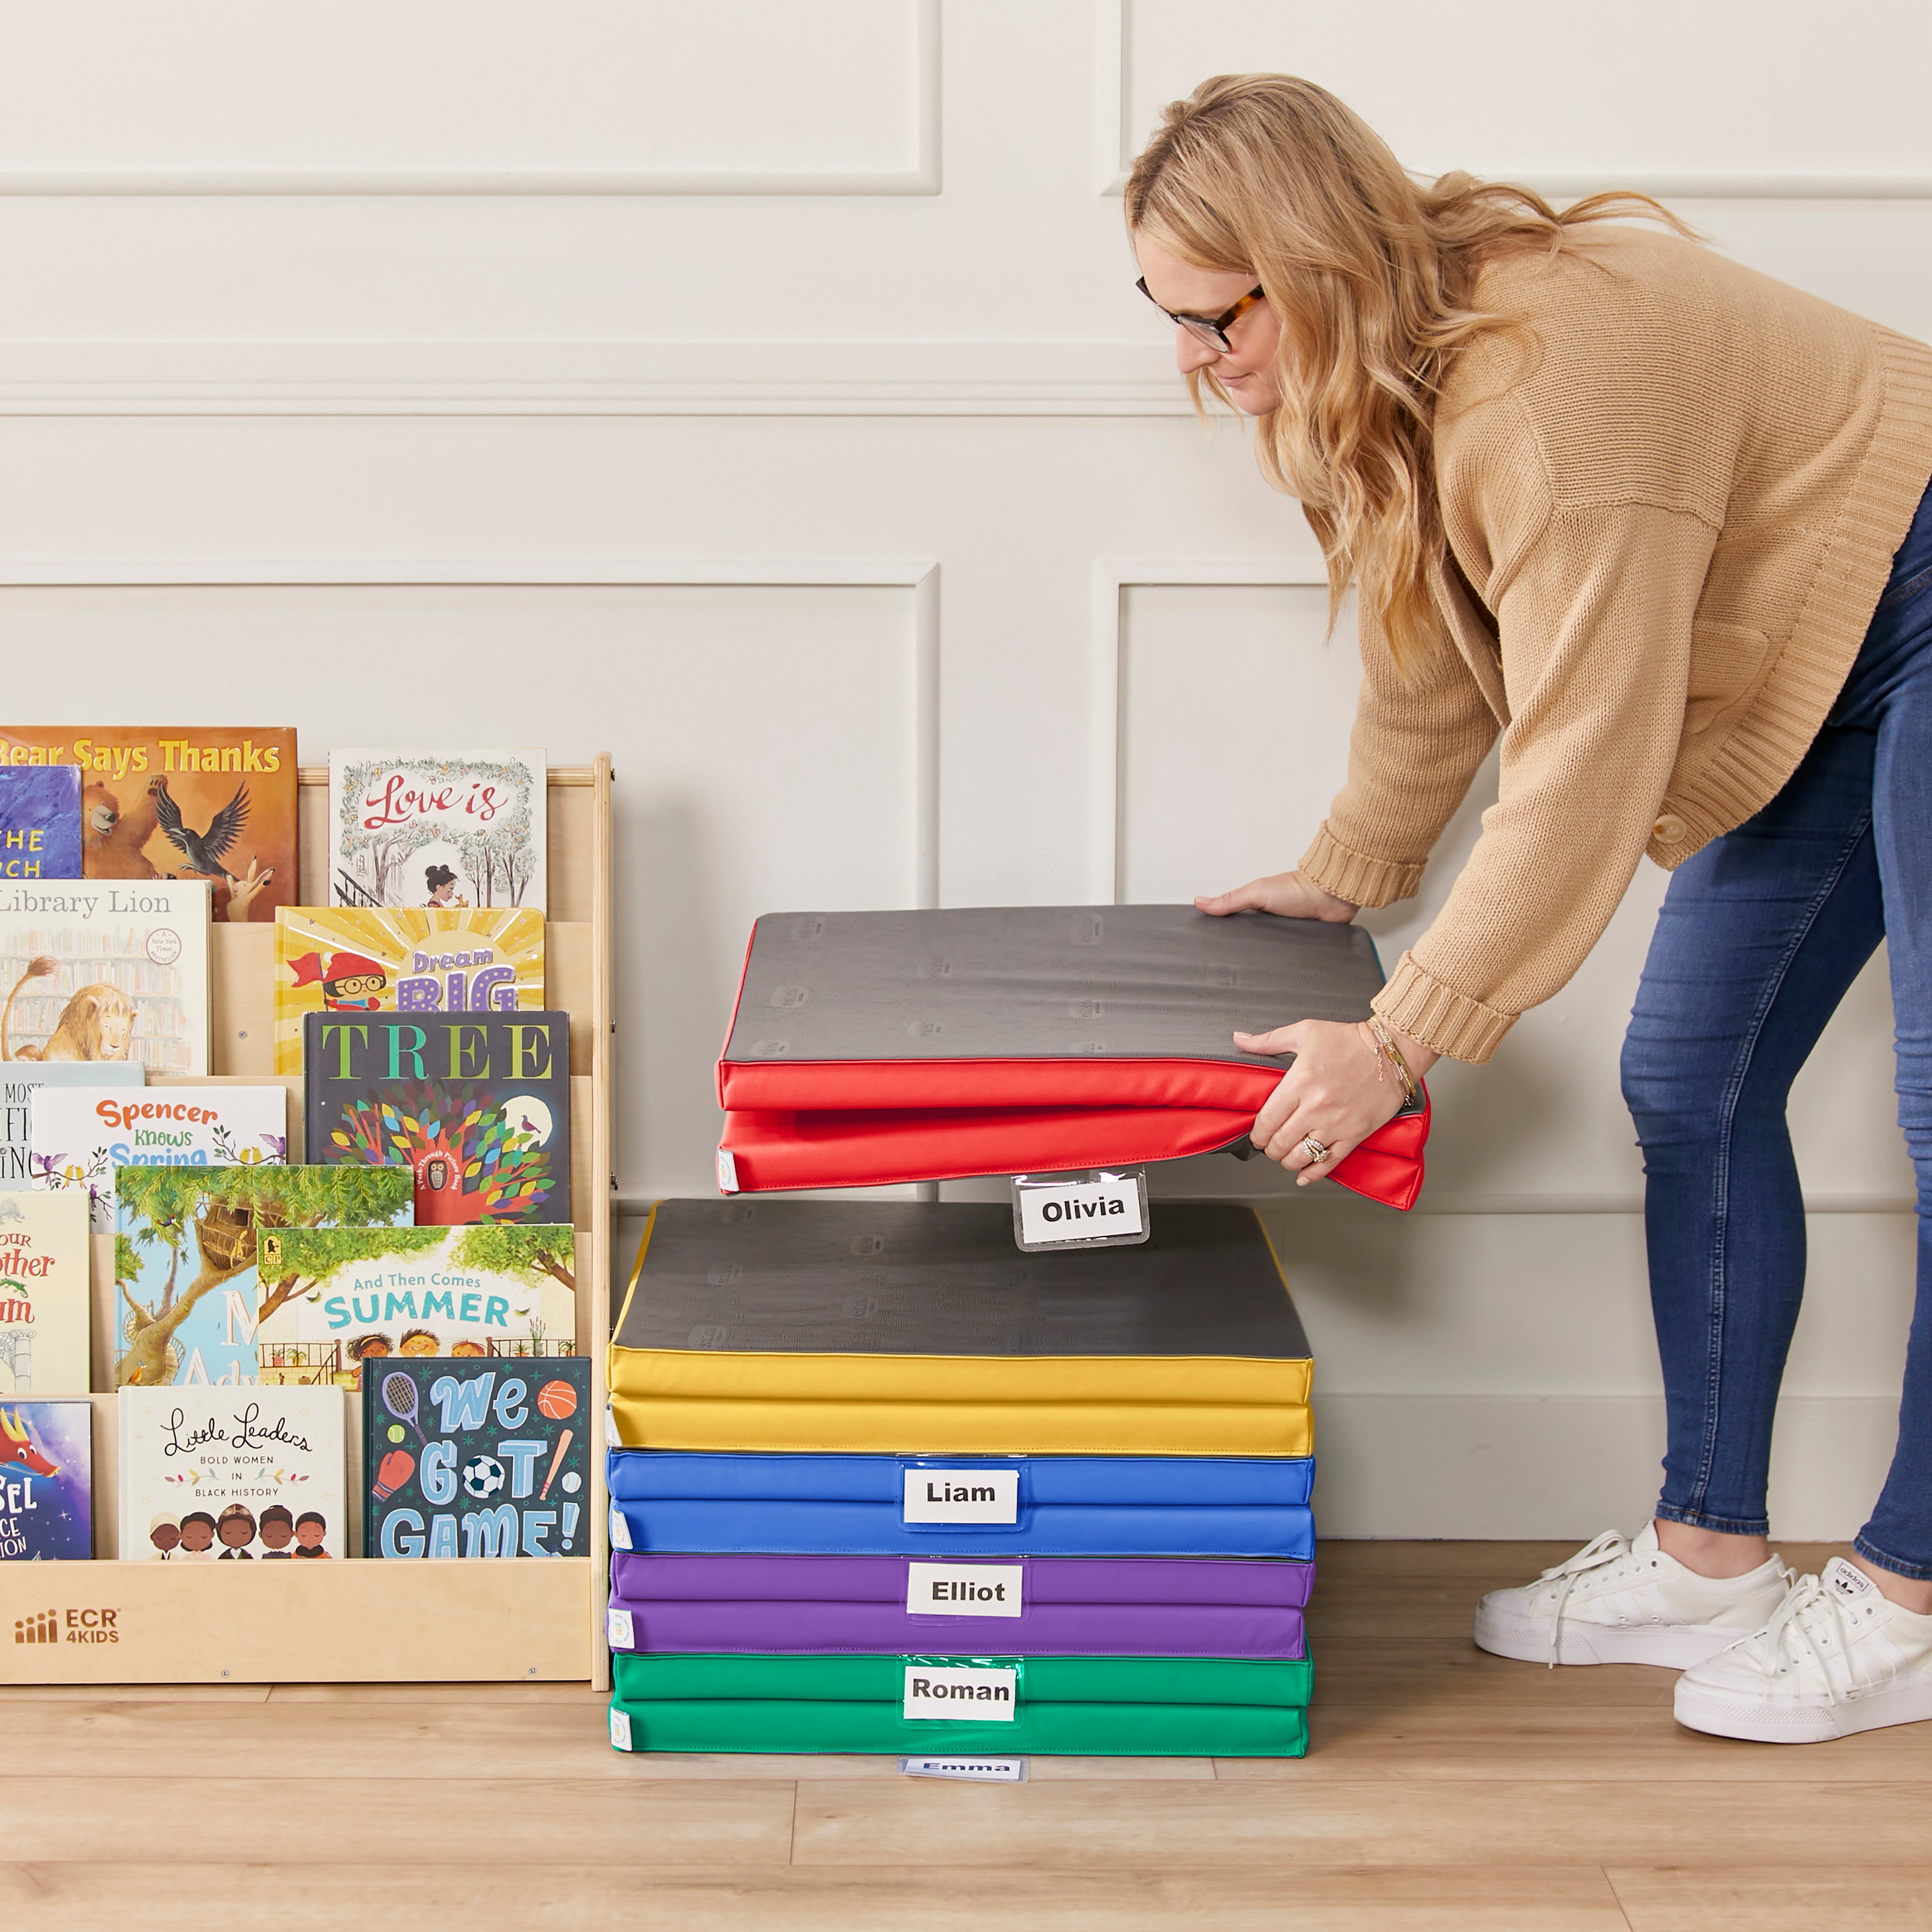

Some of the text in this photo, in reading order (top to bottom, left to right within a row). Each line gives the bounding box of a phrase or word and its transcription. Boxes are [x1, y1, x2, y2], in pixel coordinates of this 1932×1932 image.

[73, 739, 149, 781] Says
[158, 739, 280, 773] Thanks
[364, 774, 509, 830] Love is
[0, 829, 44, 852] HE
[0, 859, 40, 879] CH
[0, 890, 171, 919] Library Lion
[412, 948, 493, 974] Dream
[396, 964, 519, 1011] BIG
[322, 1024, 553, 1080] TREE
[96, 1099, 218, 1130] Spencer
[444, 1151, 459, 1173] Picture
[450, 1174, 461, 1191] Book
[1042, 1196, 1125, 1222] Olivia
[0, 1248, 56, 1278] ther
[354, 1272, 481, 1291] And Then Comes
[324, 1291, 510, 1330] SUMMER
[160, 1403, 313, 1456] Little Leaders
[200, 1456, 273, 1464] BOLD WOMEN
[195, 1488, 279, 1497] BLACK HISTORY
[927, 1482, 995, 1502] Liam
[381, 1502, 580, 1558] GAME!
[1840, 1568, 1863, 1588] adidas
[932, 1582, 1005, 1601] Elliot
[66, 1631, 119, 1643] 4KIDS
[912, 1678, 1009, 1701] Roman
[923, 1763, 1010, 1772] Emma
